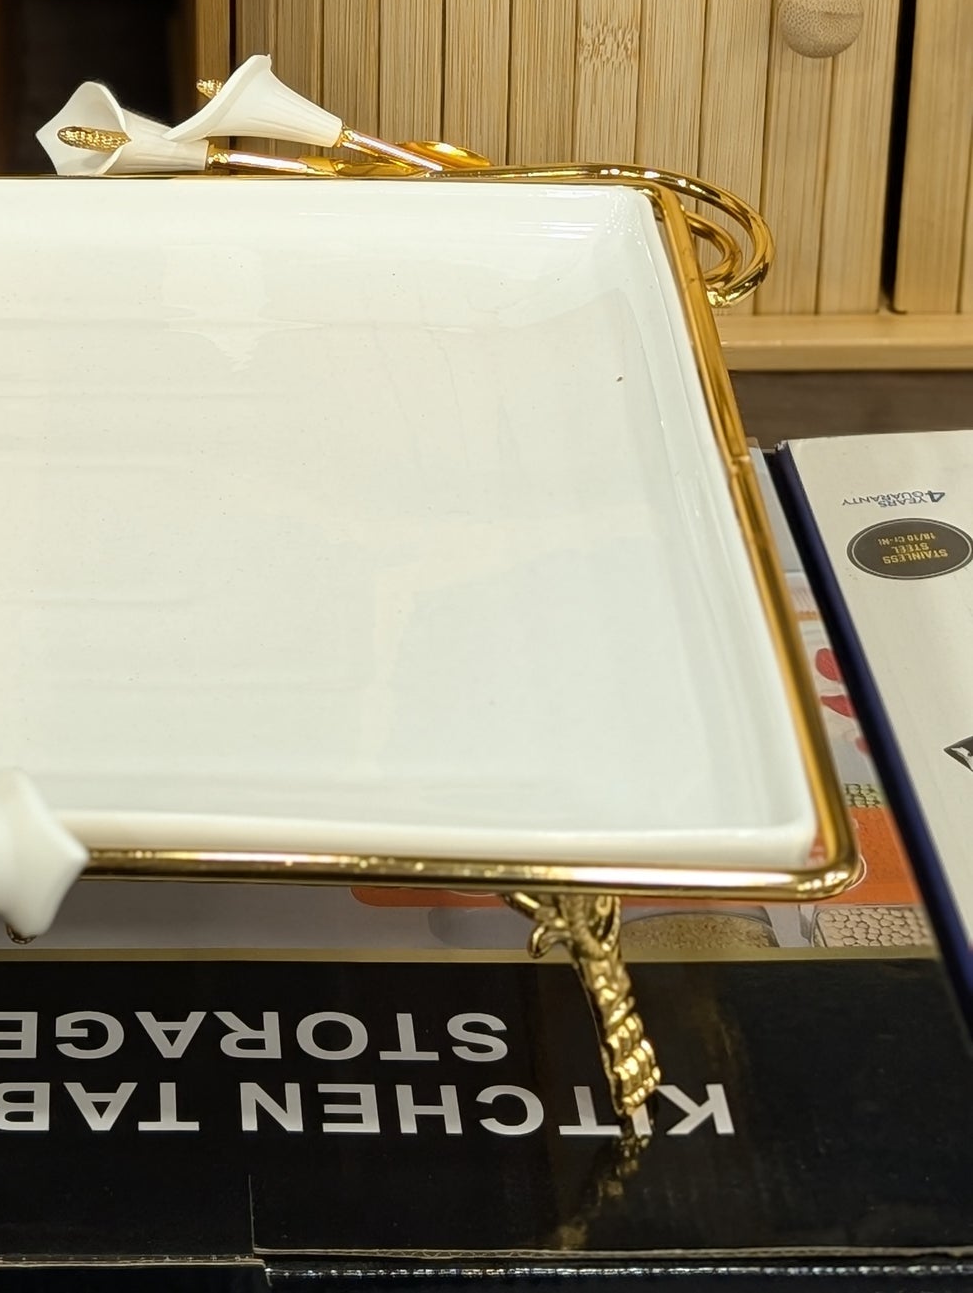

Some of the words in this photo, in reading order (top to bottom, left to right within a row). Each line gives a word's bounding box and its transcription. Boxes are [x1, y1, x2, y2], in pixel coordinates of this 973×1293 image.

[927, 490, 945, 503] 4
[891, 542, 929, 555] STEEL
[882, 549, 949, 564] STAINLESS
